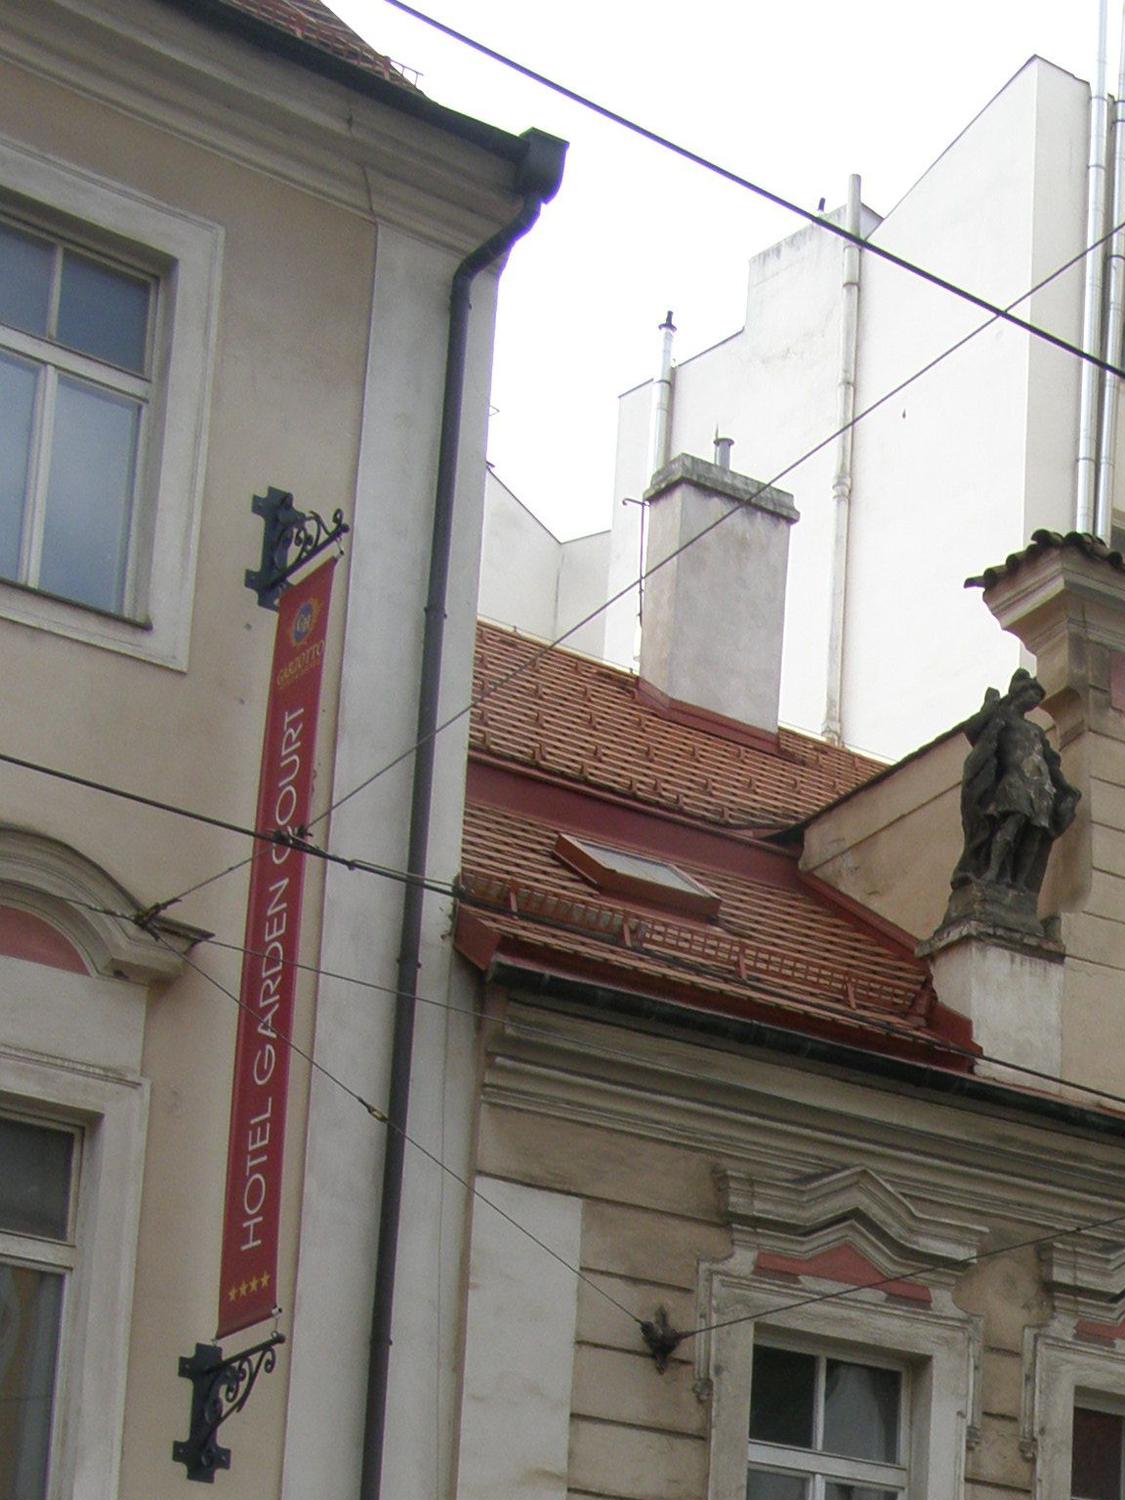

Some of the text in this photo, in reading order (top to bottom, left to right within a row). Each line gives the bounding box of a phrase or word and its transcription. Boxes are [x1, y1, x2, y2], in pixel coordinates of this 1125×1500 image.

[271, 707, 304, 865] COURT
[253, 877, 290, 1086] GARDEN
[240, 1096, 273, 1251] HOTEL
